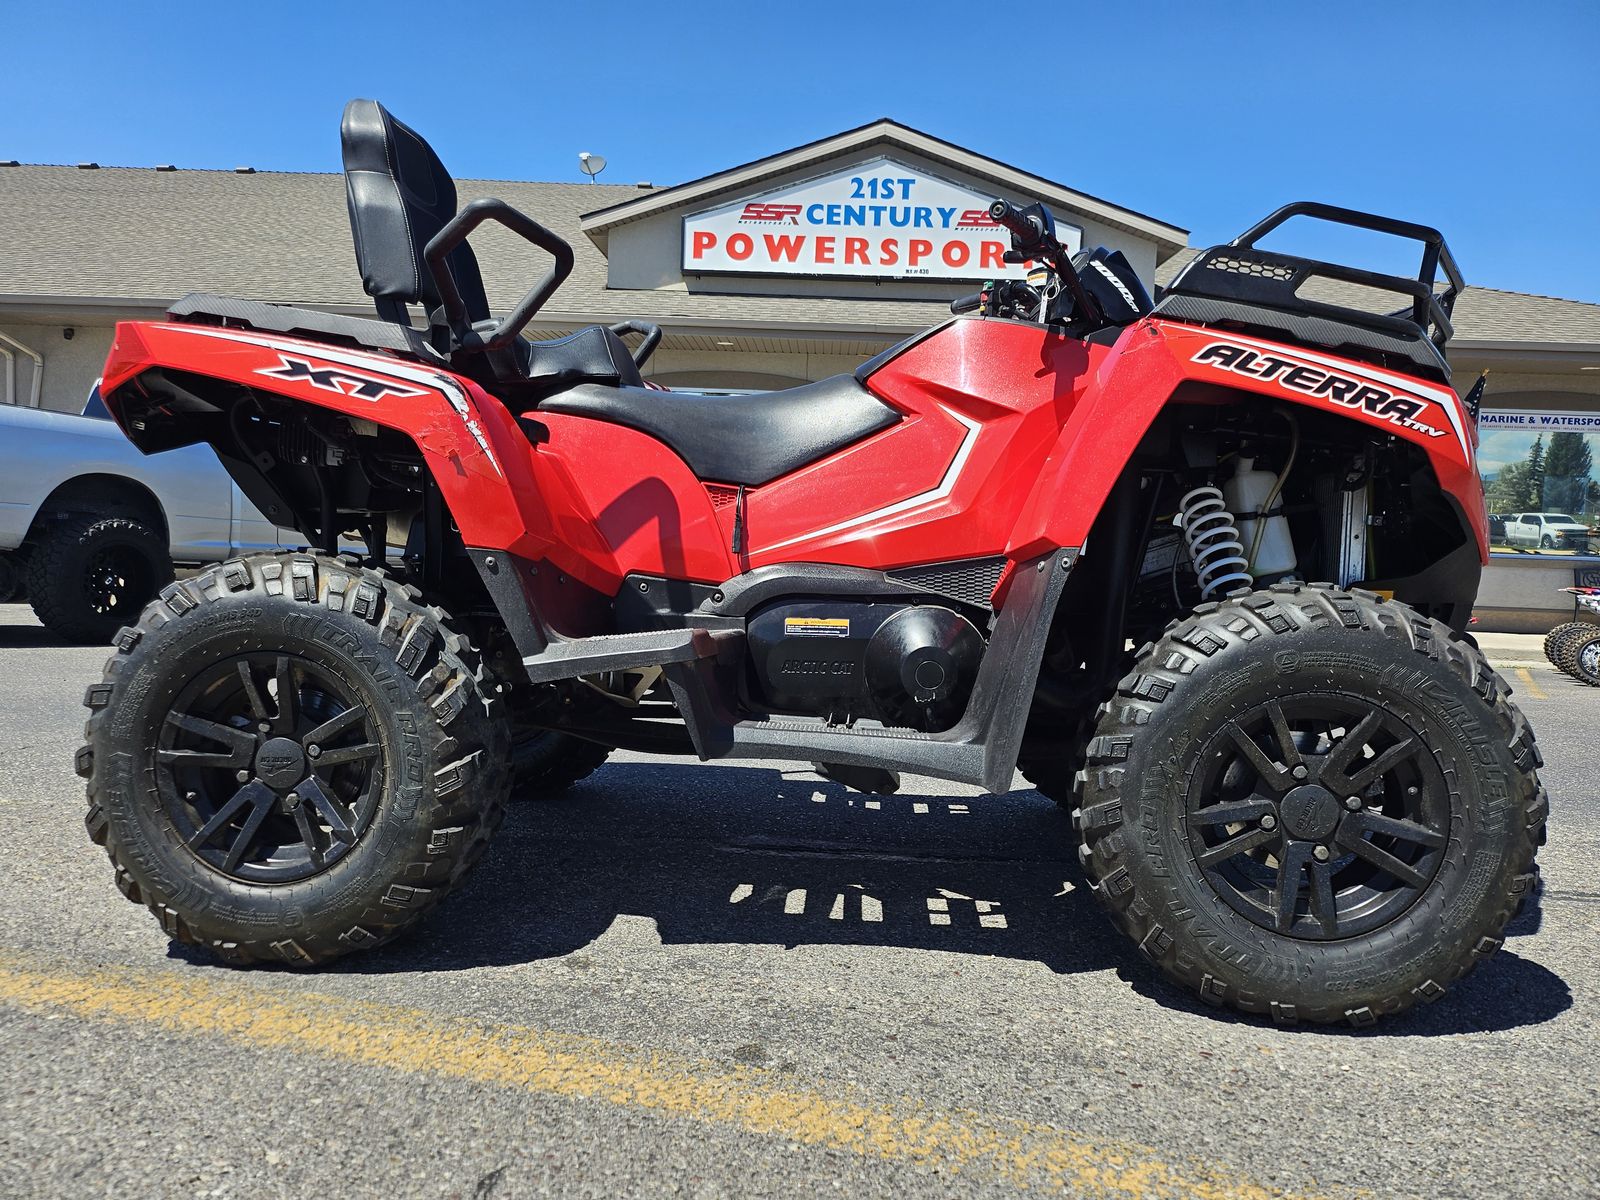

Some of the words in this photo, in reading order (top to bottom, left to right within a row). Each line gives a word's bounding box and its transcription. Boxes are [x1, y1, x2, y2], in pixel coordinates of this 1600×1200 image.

[850, 177, 916, 200] 21ST
[740, 203, 802, 225] SSR
[806, 203, 958, 229] CENTURY
[957, 209, 1001, 227] SS
[693, 231, 1068, 271] POWERSPOR
[252, 354, 431, 402] XT
[1190, 342, 1428, 425] ALTERRA
[1403, 417, 1449, 438] TRV
[1480, 414, 1525, 424] MARINE
[1528, 416, 1536, 424] &
